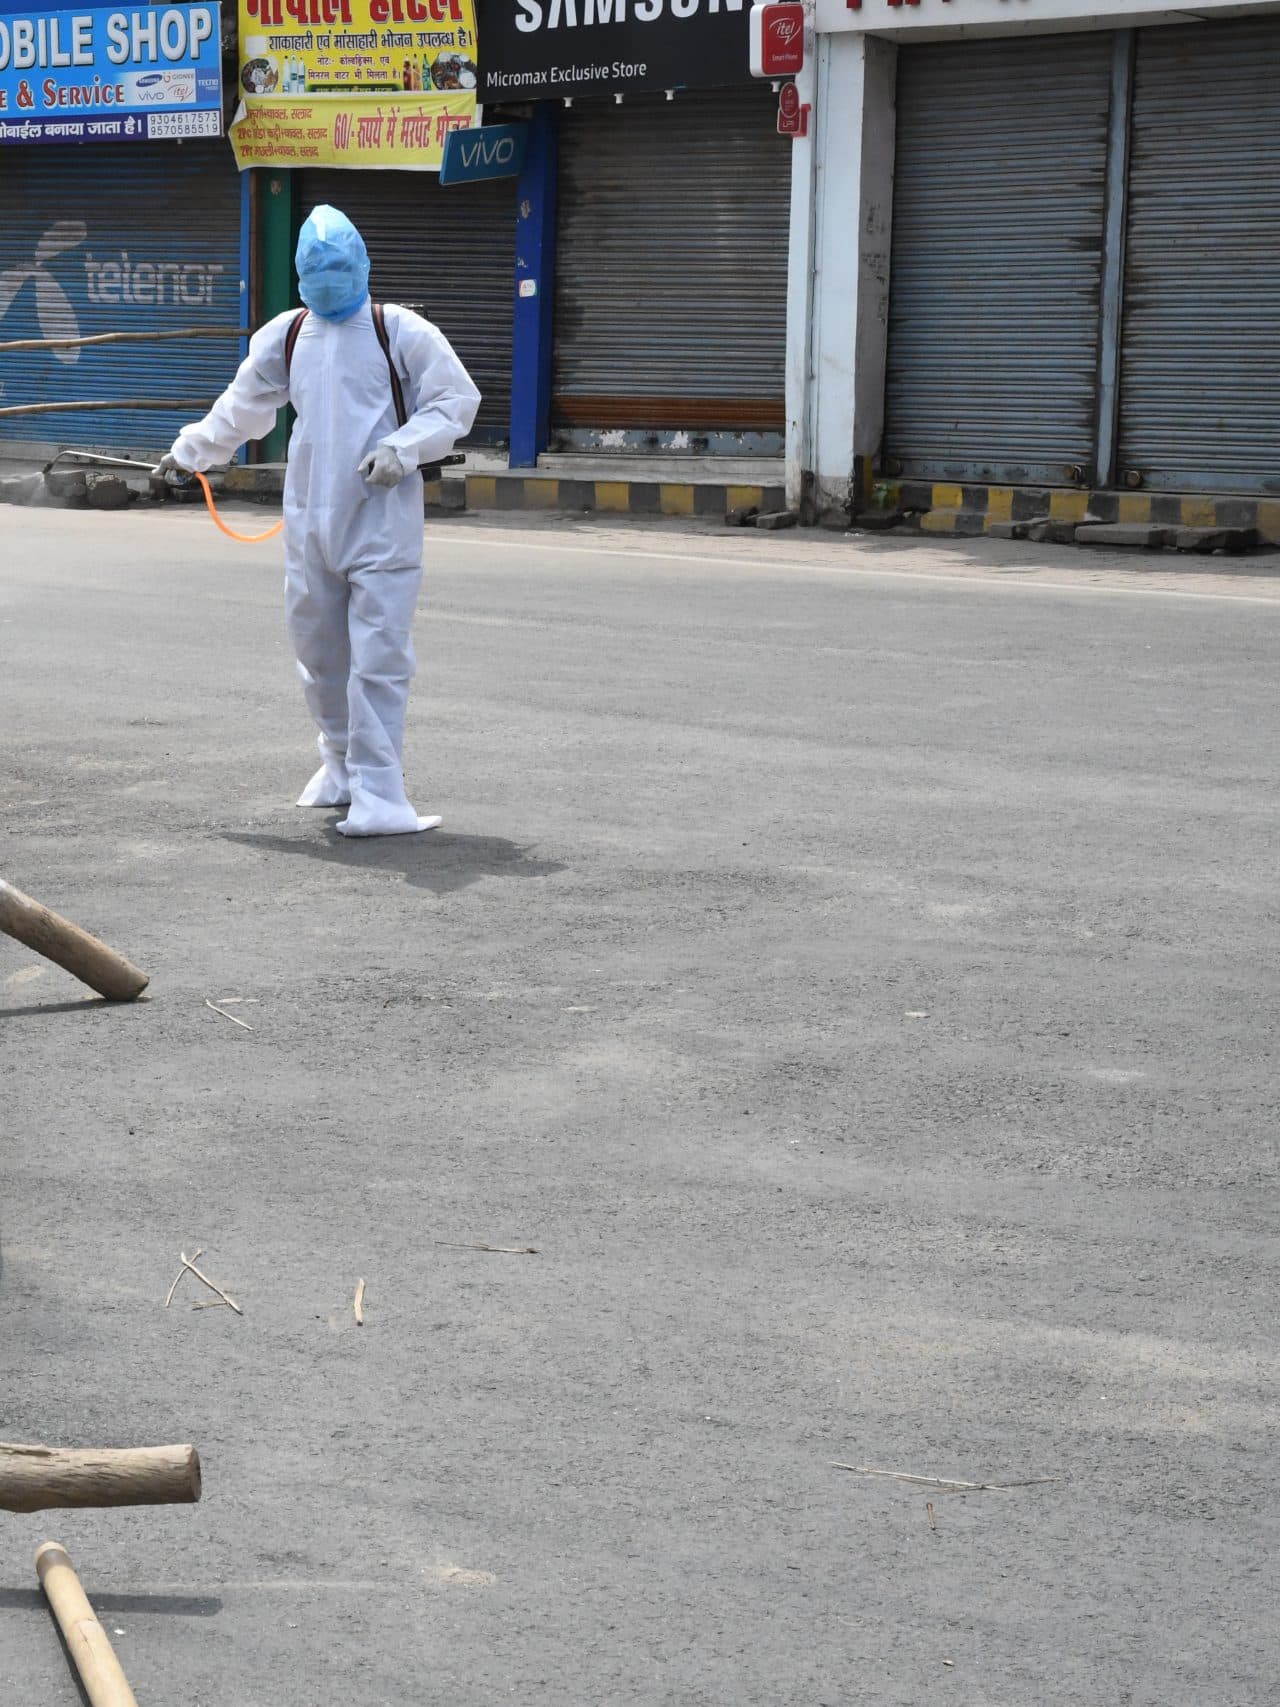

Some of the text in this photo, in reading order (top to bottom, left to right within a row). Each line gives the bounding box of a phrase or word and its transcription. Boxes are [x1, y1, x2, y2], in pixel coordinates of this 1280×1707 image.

[107, 8, 213, 63] SHOP
[380, 27, 413, 49] भोजन
[417, 29, 455, 49] उपलब्ध
[486, 61, 648, 89] Micromax Exclusive Store
[16, 81, 34, 109] &
[138, 90, 165, 101] vivo
[45, 122, 84, 137] बनाया
[87, 119, 120, 136] जाता
[461, 134, 514, 168] vivo
[84, 250, 224, 305] telenor
